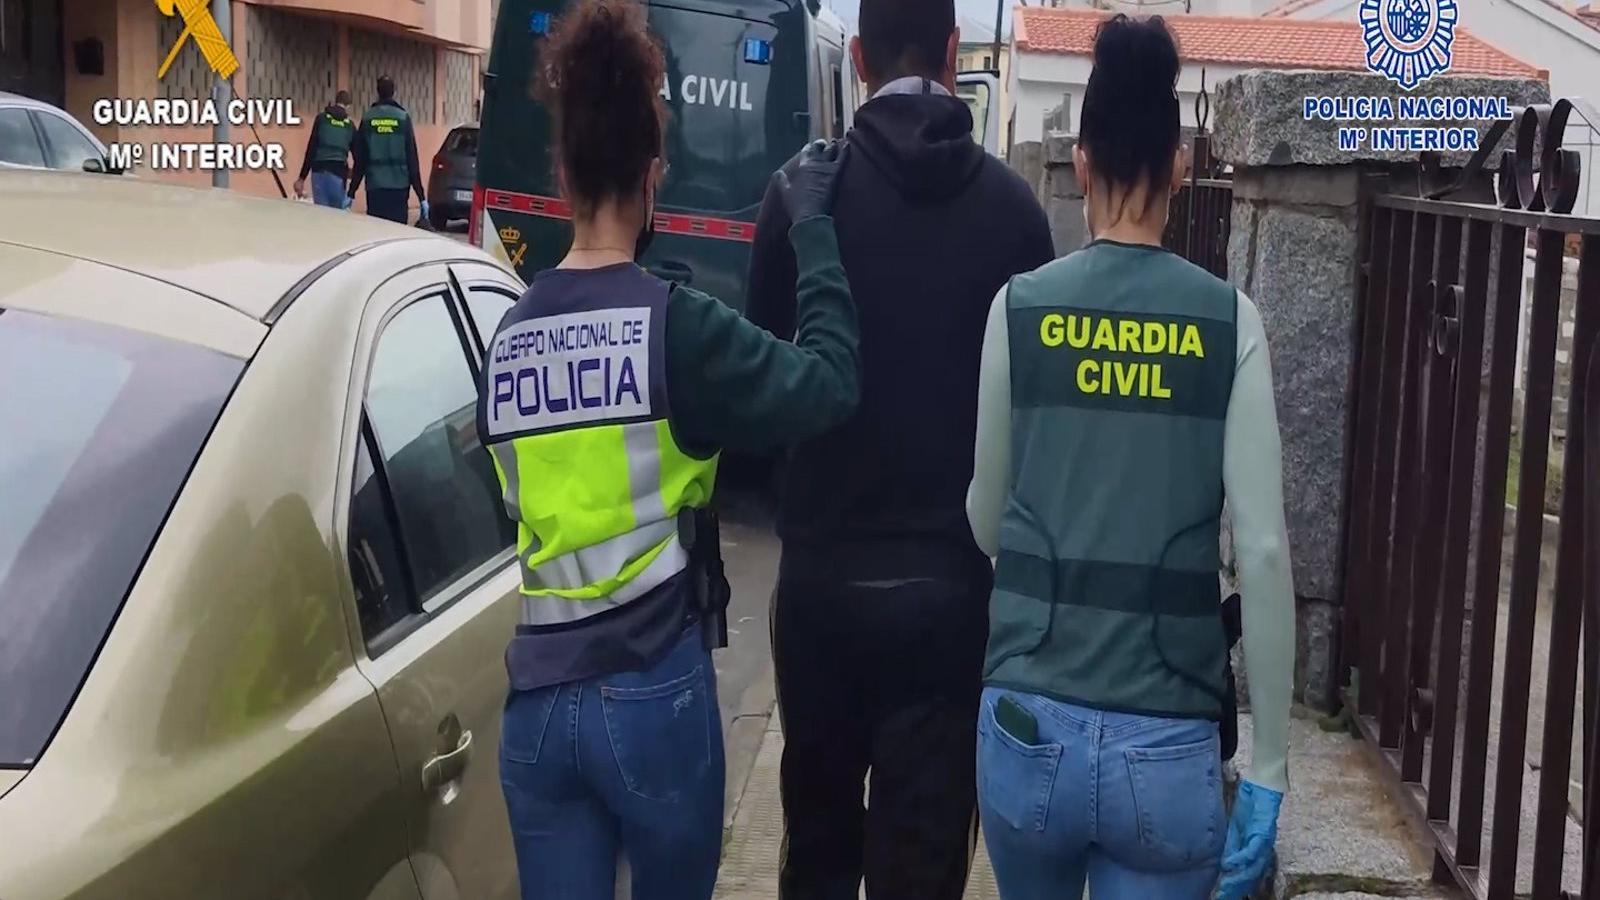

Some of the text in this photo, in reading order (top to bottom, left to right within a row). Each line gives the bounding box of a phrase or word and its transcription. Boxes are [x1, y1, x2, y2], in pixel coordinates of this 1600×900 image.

[681, 74, 752, 111] CIVIL
[371, 119, 398, 127] GUARDIA
[495, 320, 643, 363] CUERPO NACIONAL DE
[1040, 313, 1205, 358] GUARDIA
[494, 356, 642, 421] POLICIA
[1076, 359, 1172, 398] CIVIL
